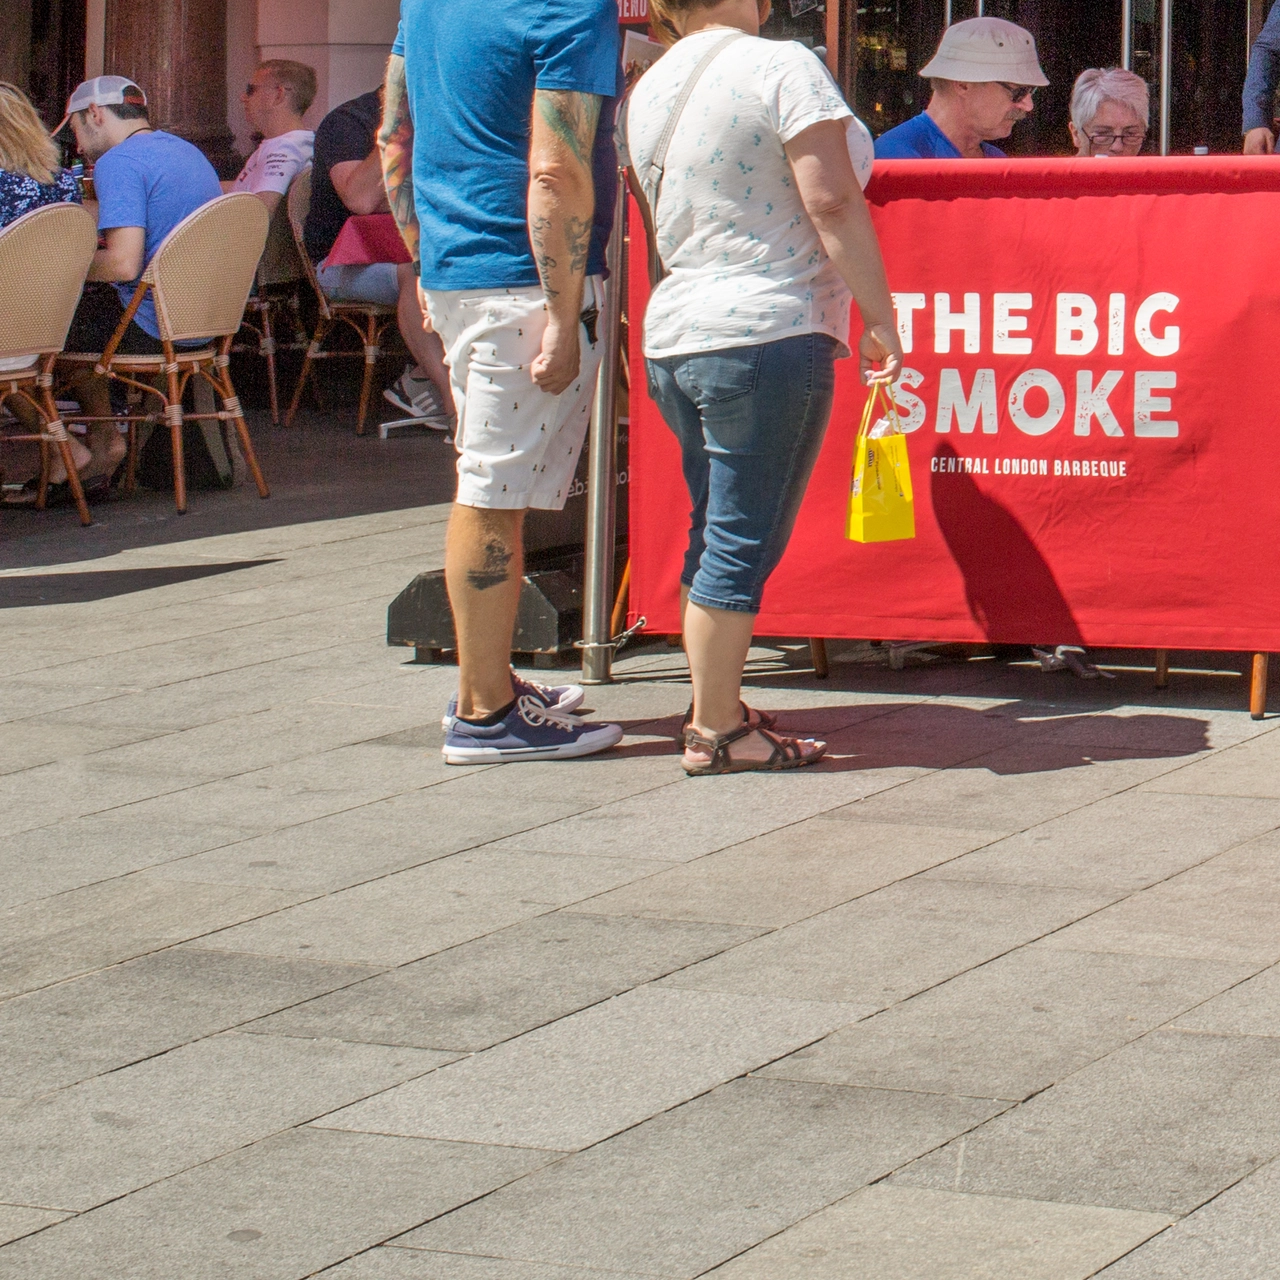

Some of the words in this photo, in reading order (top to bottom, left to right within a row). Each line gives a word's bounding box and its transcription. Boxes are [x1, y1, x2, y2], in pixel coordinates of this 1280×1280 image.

[891, 291, 1033, 356] THE
[1054, 291, 1181, 357] BIG
[887, 368, 1180, 439] SMOKE
[930, 455, 991, 476] CENTRAL
[994, 458, 1048, 477] LONDON
[1053, 459, 1128, 479] BARBEQUE
